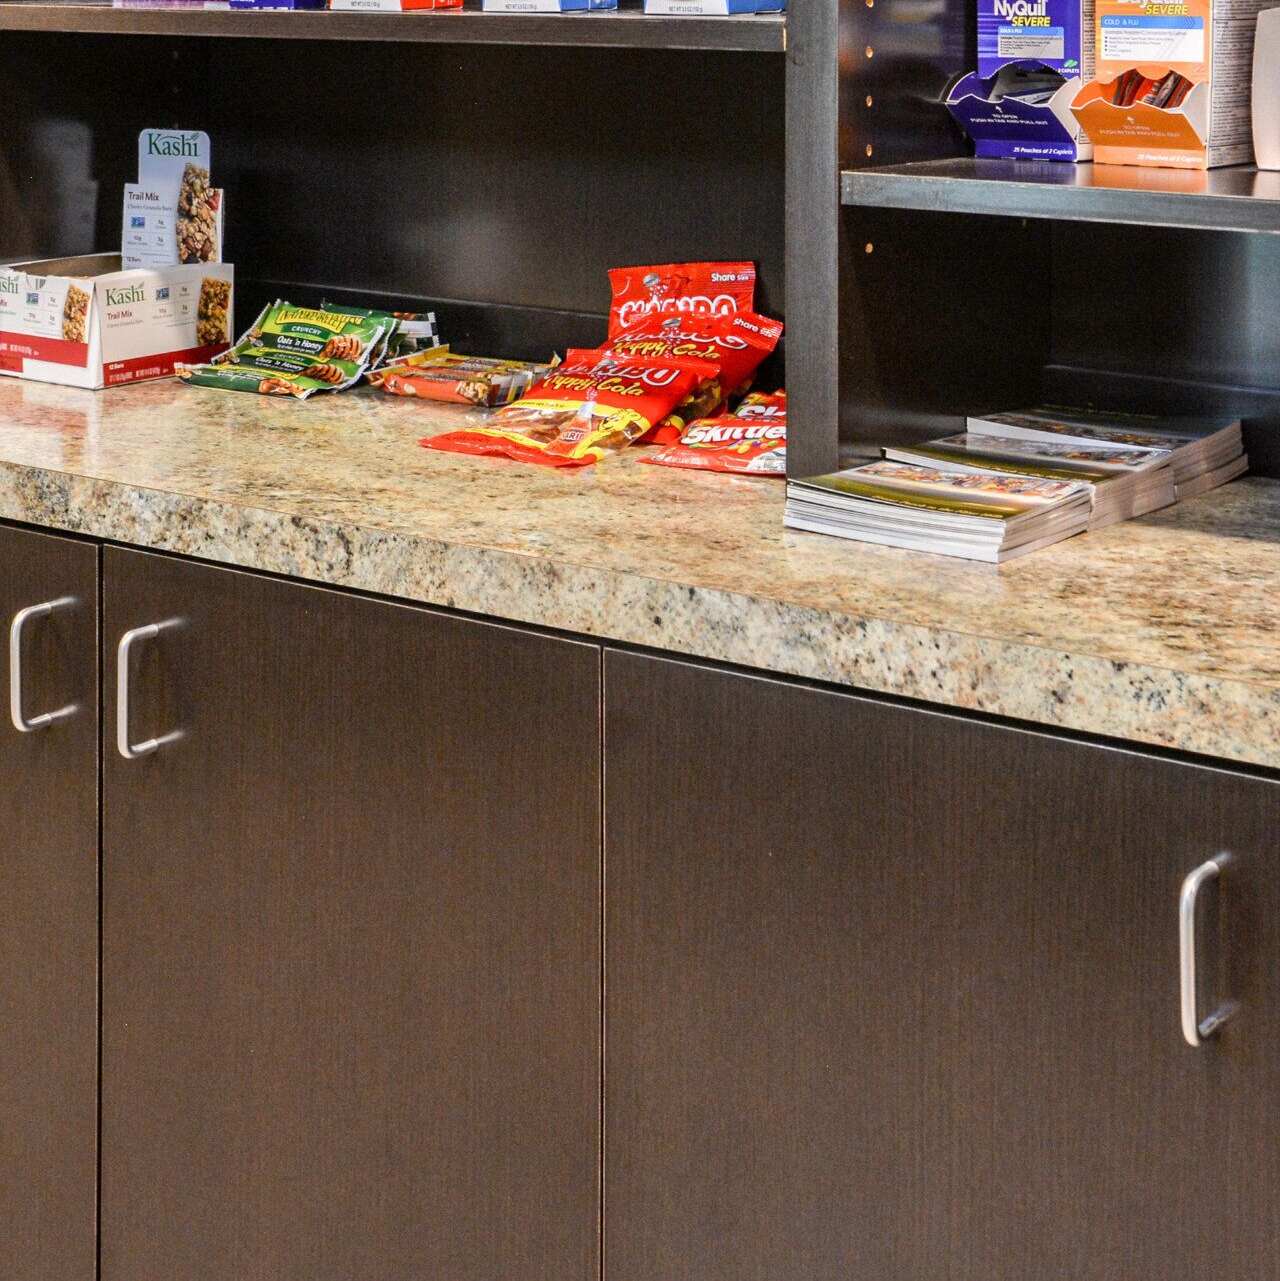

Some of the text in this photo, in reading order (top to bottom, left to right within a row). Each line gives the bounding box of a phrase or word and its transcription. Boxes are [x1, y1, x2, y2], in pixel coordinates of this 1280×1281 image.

[994, 0, 1047, 20] NyQuil
[1146, 5, 1188, 15] SEVERE
[1012, 16, 1051, 27] SEVERE
[148, 132, 200, 157] Kashi
[128, 191, 159, 201] Trail Mix
[711, 274, 735, 282] Share
[105, 284, 145, 306] Kashi
[107, 310, 133, 320] Trail Mix
[292, 326, 321, 334] CRUNCHY
[277, 336, 323, 352] Oats Honey
[672, 344, 721, 359] Cola
[597, 378, 645, 396] Cola
[681, 425, 785, 444] Skittle
